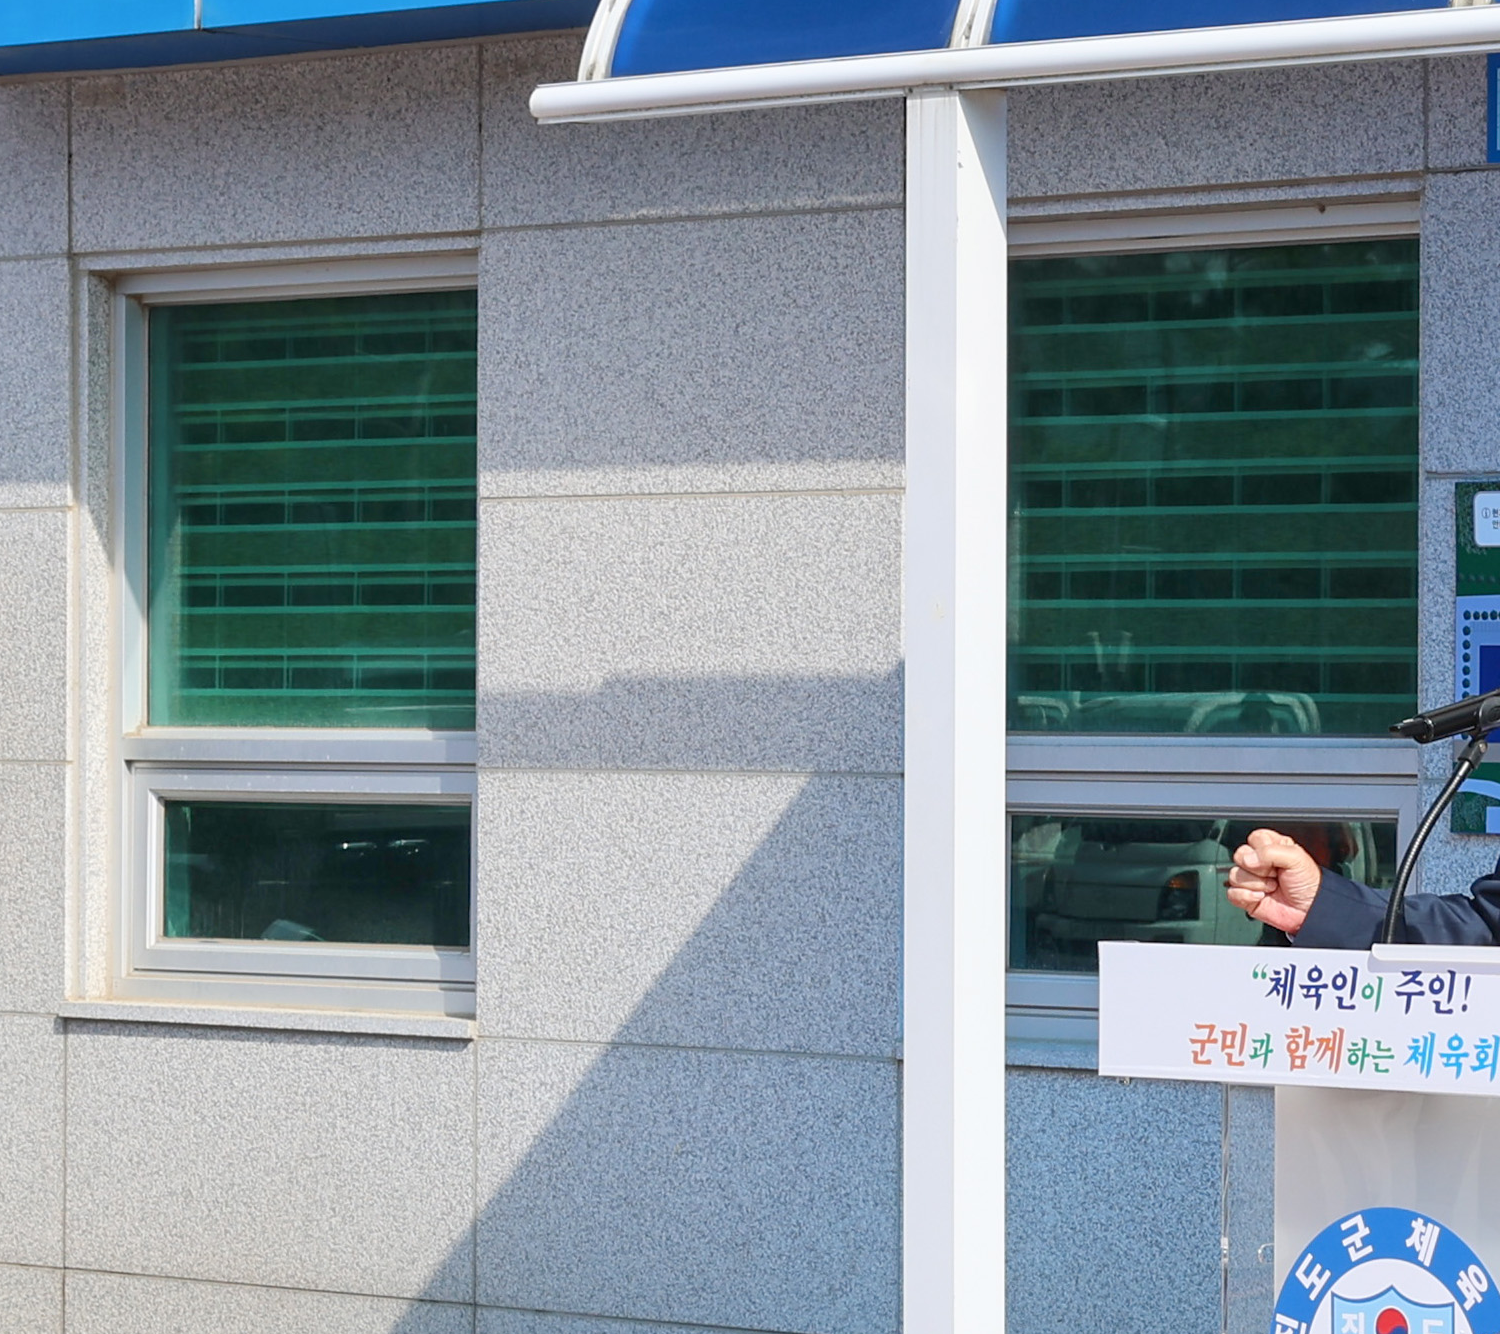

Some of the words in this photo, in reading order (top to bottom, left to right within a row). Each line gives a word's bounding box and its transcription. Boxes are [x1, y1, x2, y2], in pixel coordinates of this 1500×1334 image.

[1395, 968, 1472, 1015] 주인!
[1188, 1022, 1274, 1068] 군민과
[1285, 1025, 1395, 1075] 함께하는
